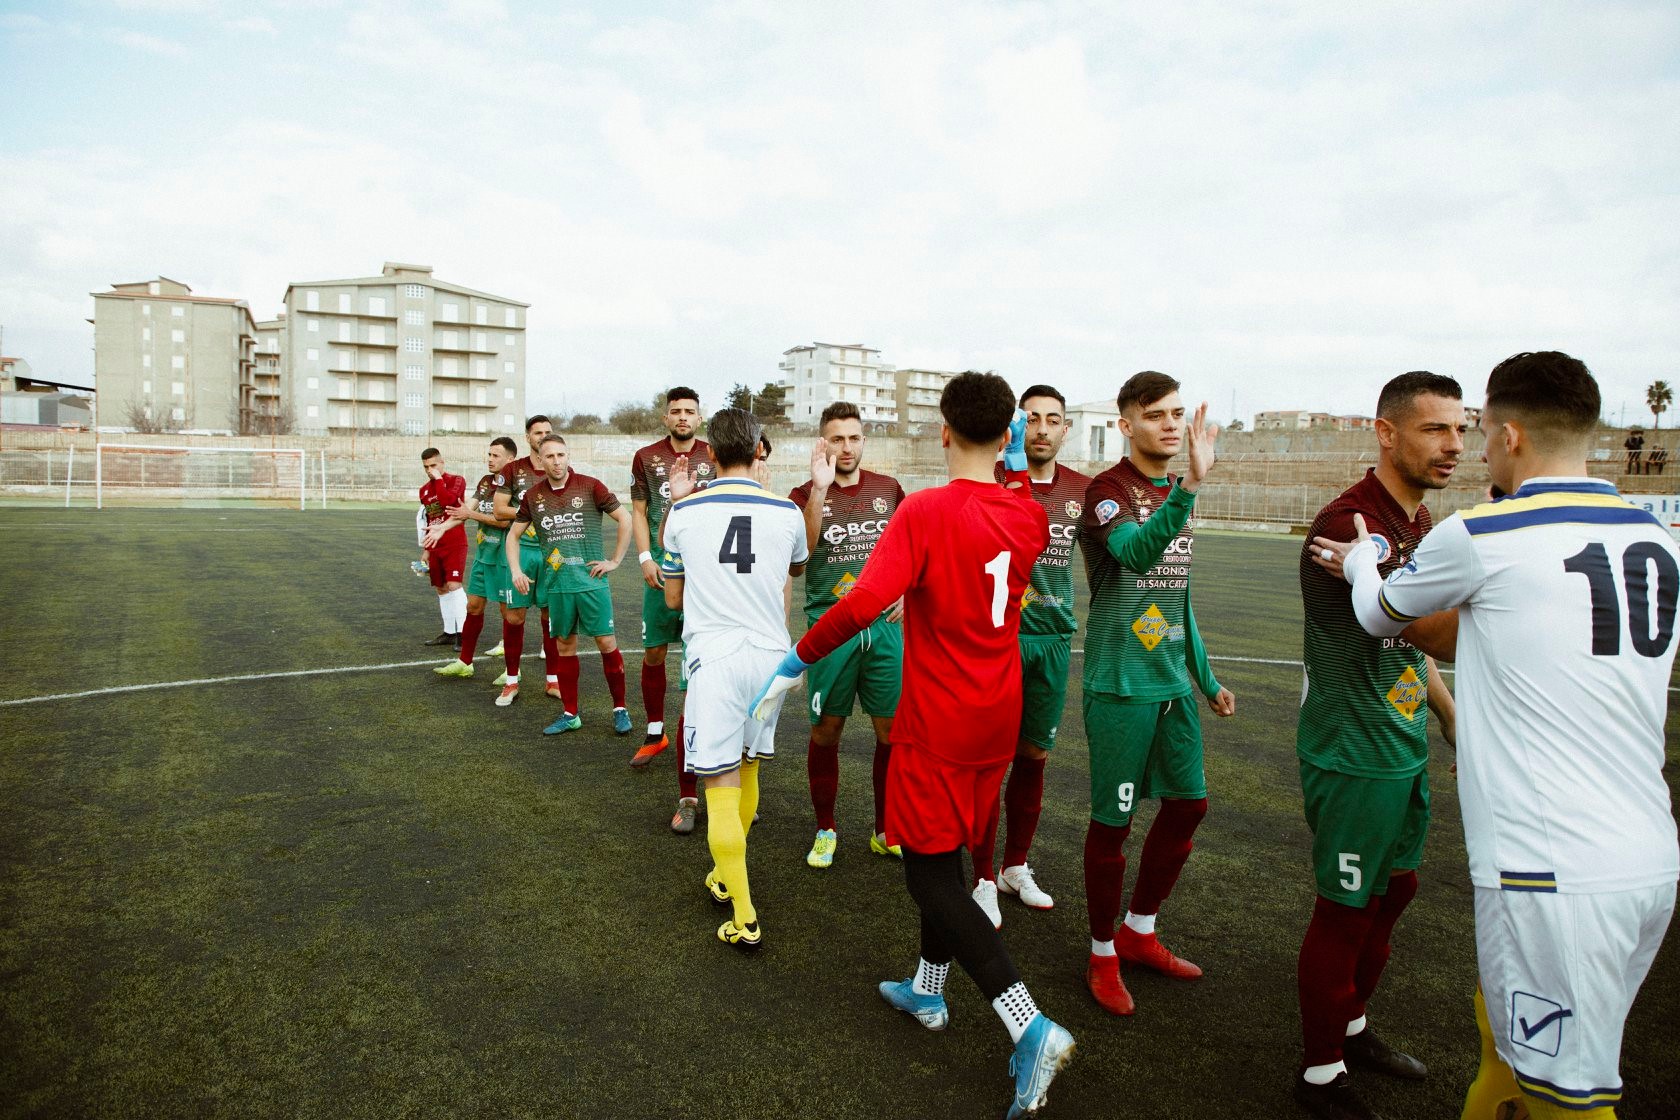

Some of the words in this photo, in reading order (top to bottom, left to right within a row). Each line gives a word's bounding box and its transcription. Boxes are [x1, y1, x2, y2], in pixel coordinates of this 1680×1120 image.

[554, 513, 584, 525] BCC
[719, 516, 756, 574] 4
[838, 553, 857, 562] SAN
[985, 550, 1011, 628] 1
[1137, 579, 1146, 588] DI
[1148, 579, 1167, 588] SAN
[506, 590, 513, 604] 11
[1563, 541, 1680, 658] 10
[1383, 637, 1395, 649] DI
[811, 691, 822, 716] 4
[1394, 688, 1413, 704] La
[1117, 782, 1135, 813] 9
[1338, 852, 1362, 892] 5
